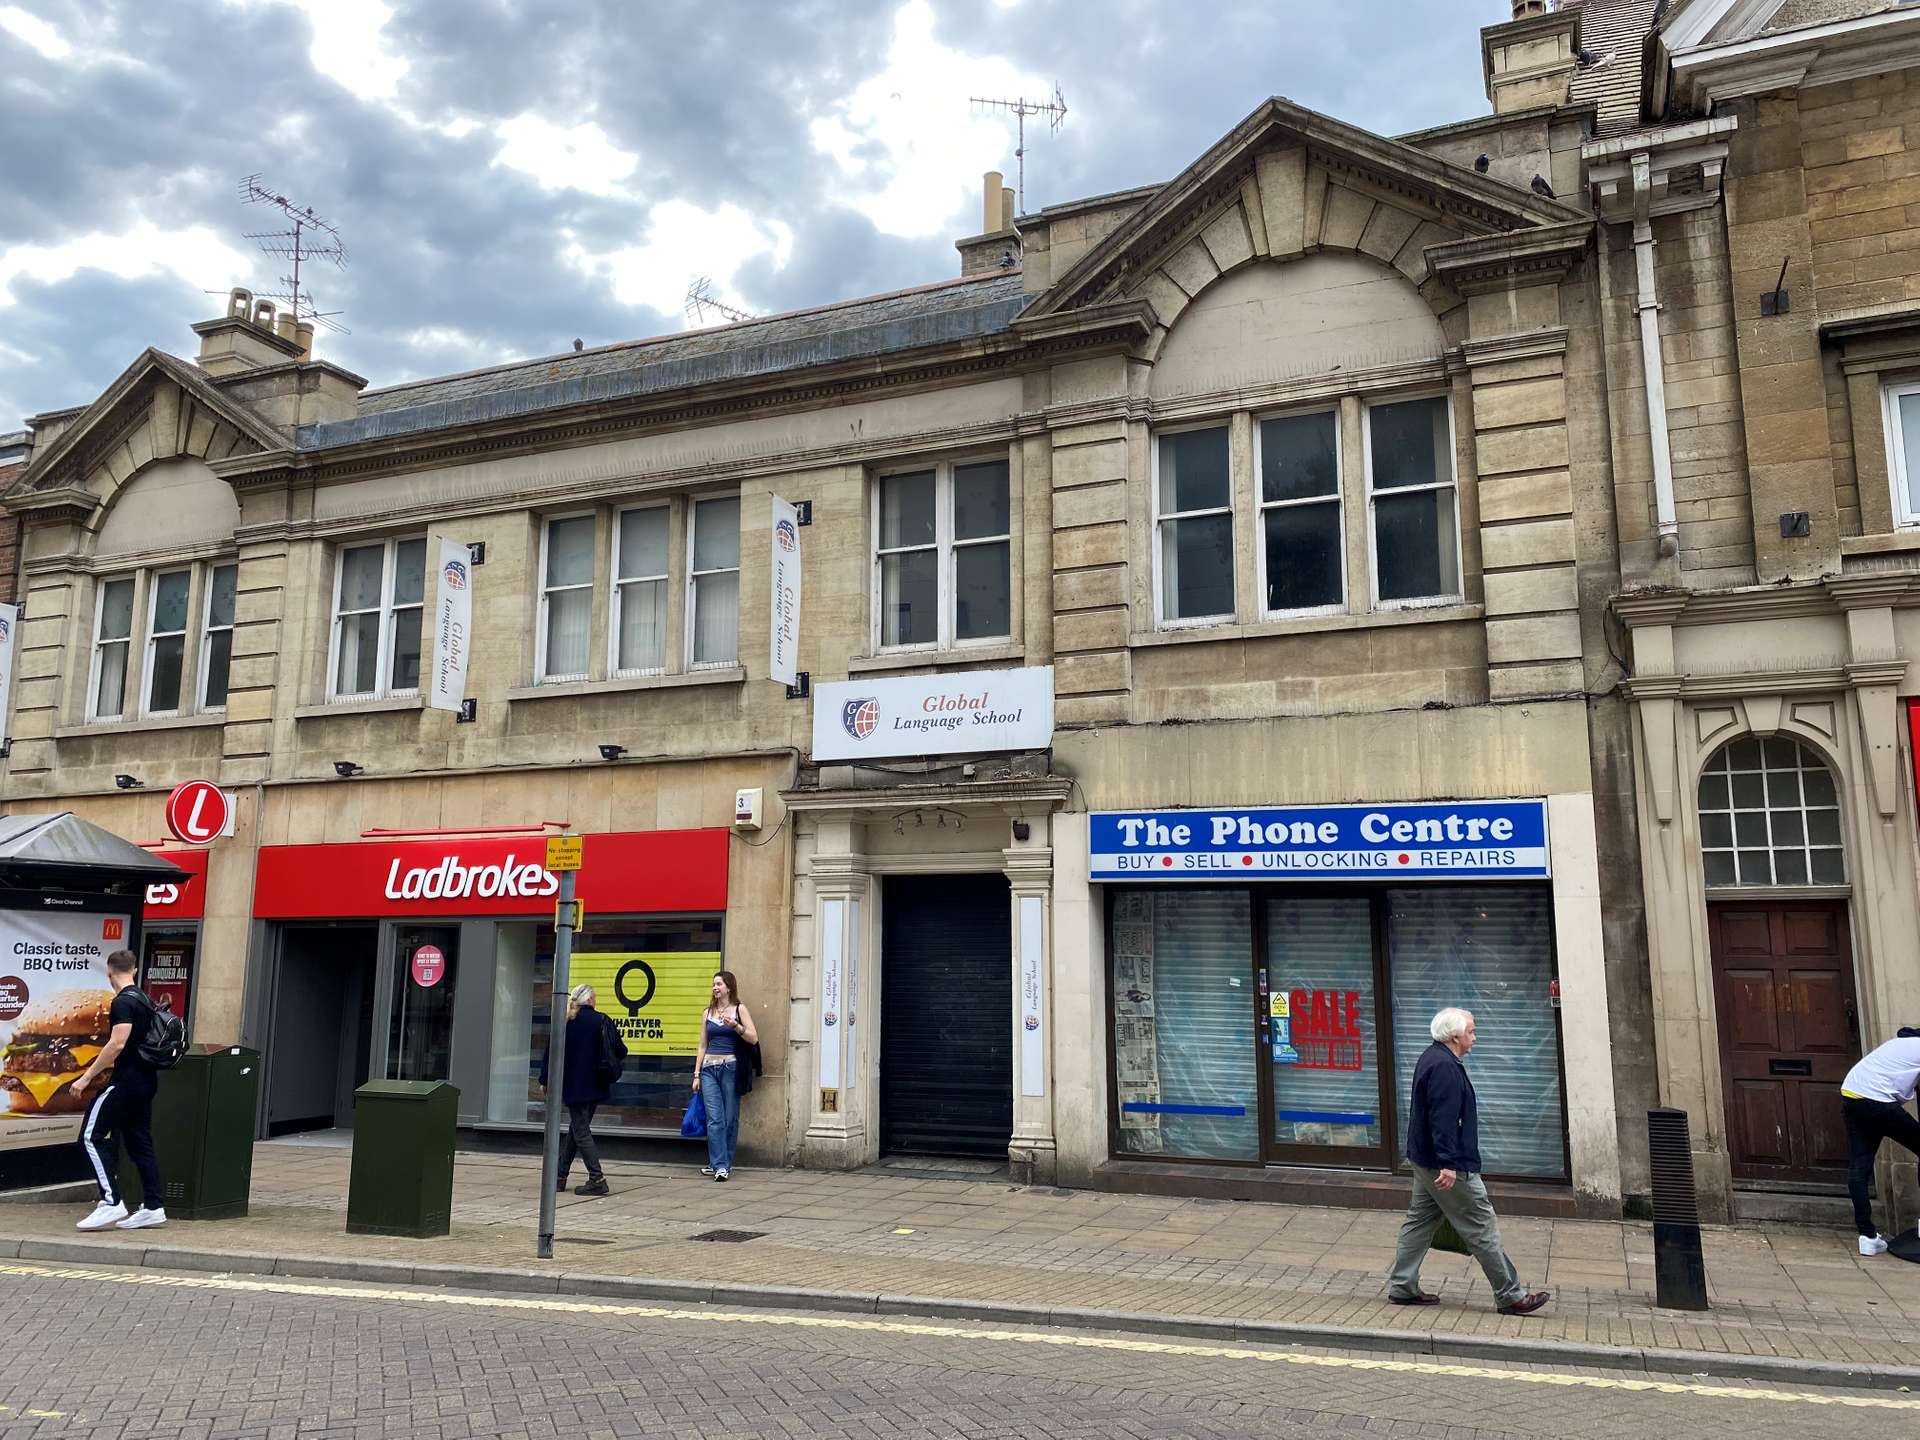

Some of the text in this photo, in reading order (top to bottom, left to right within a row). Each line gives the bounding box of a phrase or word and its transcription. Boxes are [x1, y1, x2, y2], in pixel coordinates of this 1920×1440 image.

[776, 559, 784, 666] Language School
[783, 586, 794, 642] Global
[439, 597, 453, 695] Language School
[450, 621, 463, 672] Global
[922, 692, 989, 713] Global
[893, 708, 1023, 733] Language School
[1116, 812, 1515, 848] The Phone Centre
[1117, 849, 1516, 869] BUY SELL UNLOCKING REPAIRS
[384, 854, 559, 900] Ladbrokes
[13, 942, 101, 957] Classic taste,
[157, 955, 181, 967] TIME TO
[23, 957, 90, 972] BBQ twist
[147, 967, 188, 980] CONQUER ALL
[1290, 987, 1361, 1037] SALE
[627, 1029, 646, 1039] BET
[647, 1029, 664, 1039] ON
